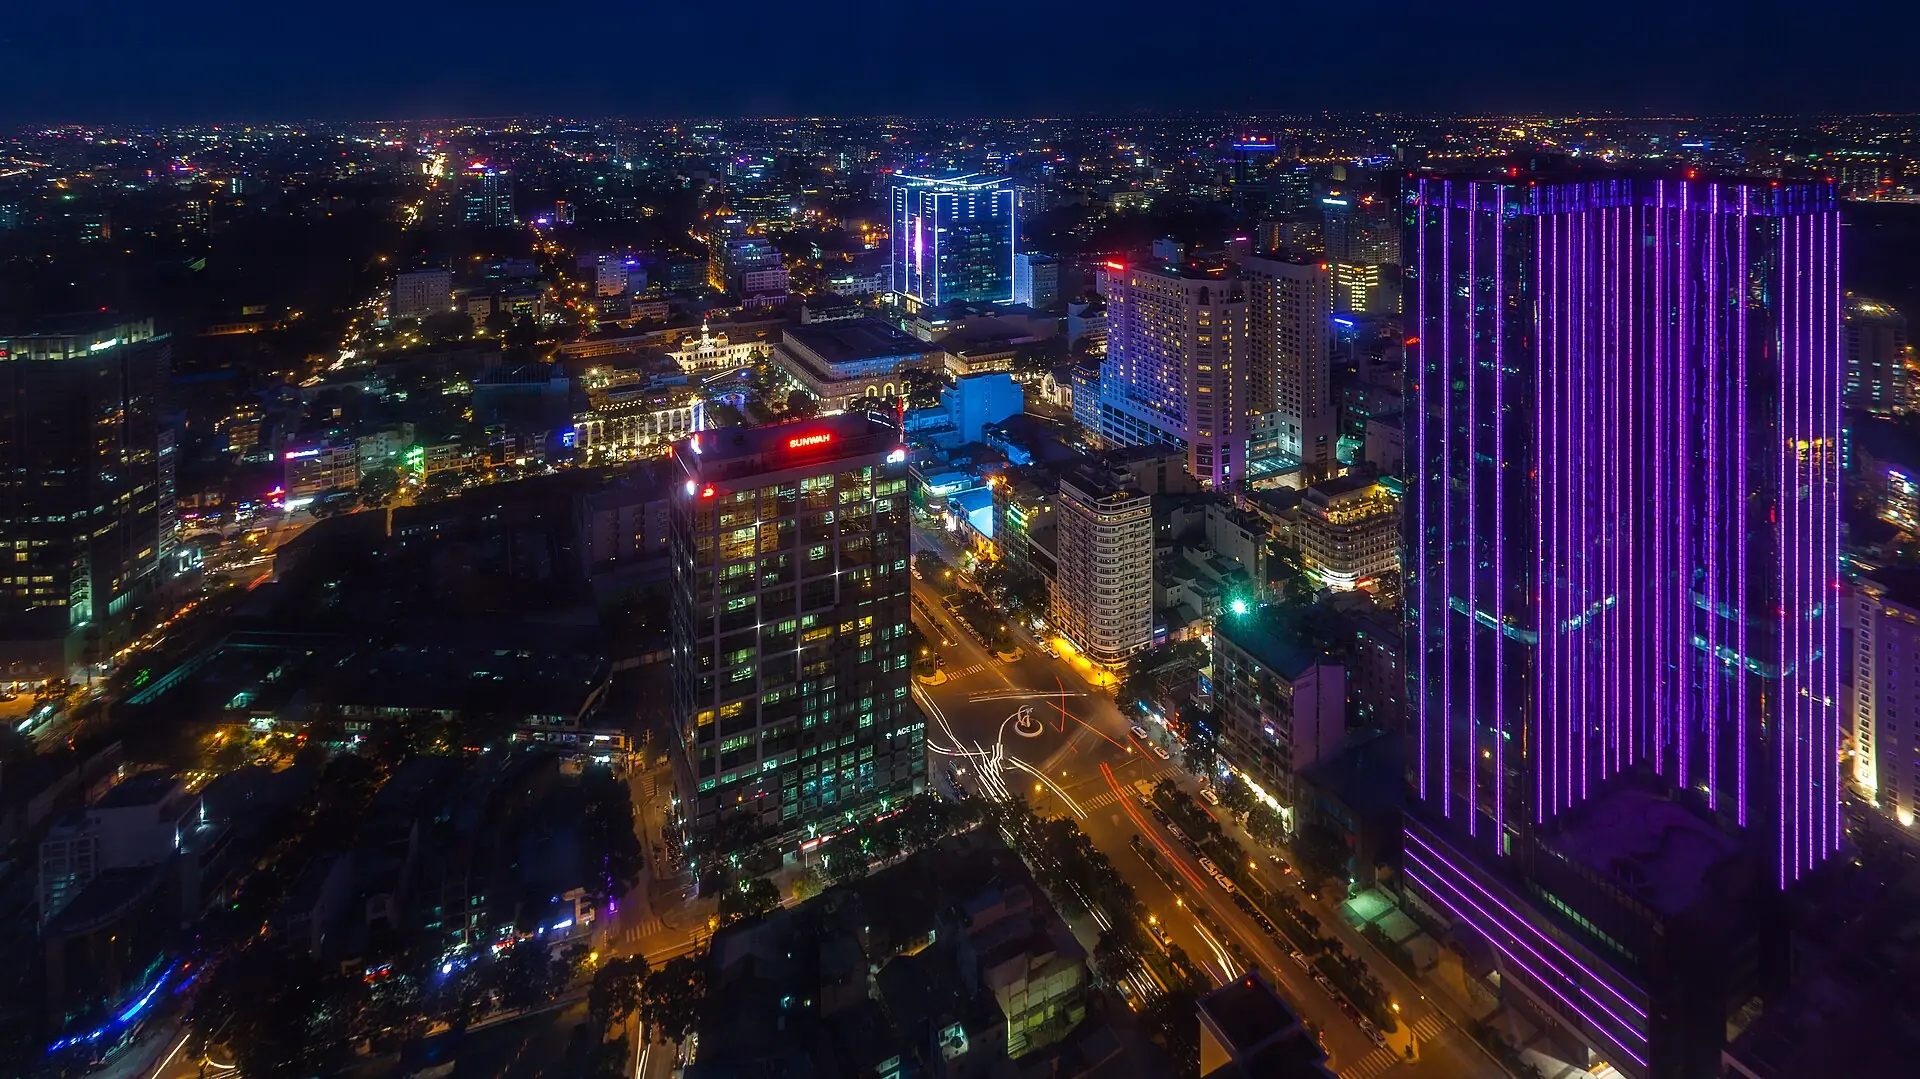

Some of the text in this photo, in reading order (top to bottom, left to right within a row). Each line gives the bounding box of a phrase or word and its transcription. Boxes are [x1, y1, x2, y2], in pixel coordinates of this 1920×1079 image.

[789, 434, 830, 448] SUNWAH
[896, 722, 924, 737] ACE Life
